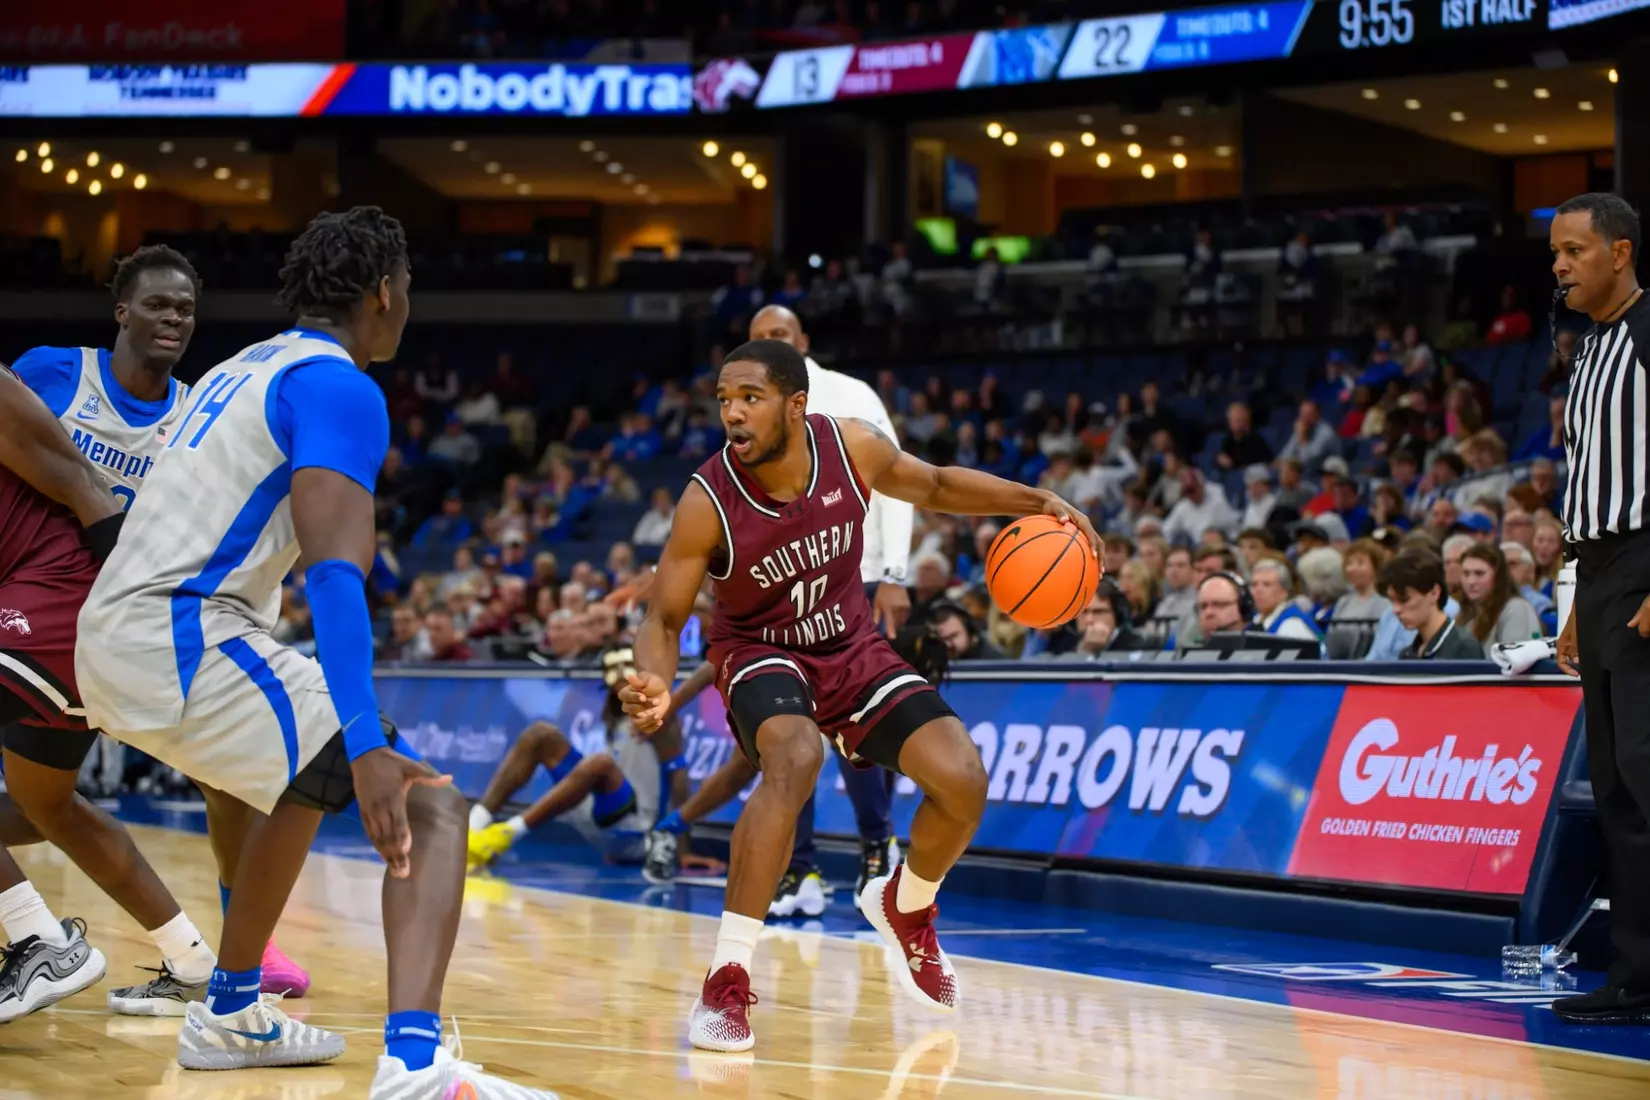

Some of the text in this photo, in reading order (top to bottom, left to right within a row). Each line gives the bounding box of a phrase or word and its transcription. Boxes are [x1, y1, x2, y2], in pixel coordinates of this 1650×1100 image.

[1339, 0, 1414, 48] 9:55
[1481, 0, 1536, 24] HALF
[1094, 25, 1132, 68] 22
[167, 371, 255, 450] 14
[71, 427, 154, 479] Memph
[749, 520, 855, 590] SOUTHERN
[790, 574, 829, 619] 10
[964, 721, 1245, 818] ORROWS
[1338, 717, 1543, 806] Guthrie's
[1321, 817, 1522, 847] GOLDEN FRIED CHICKEN FINGERS
